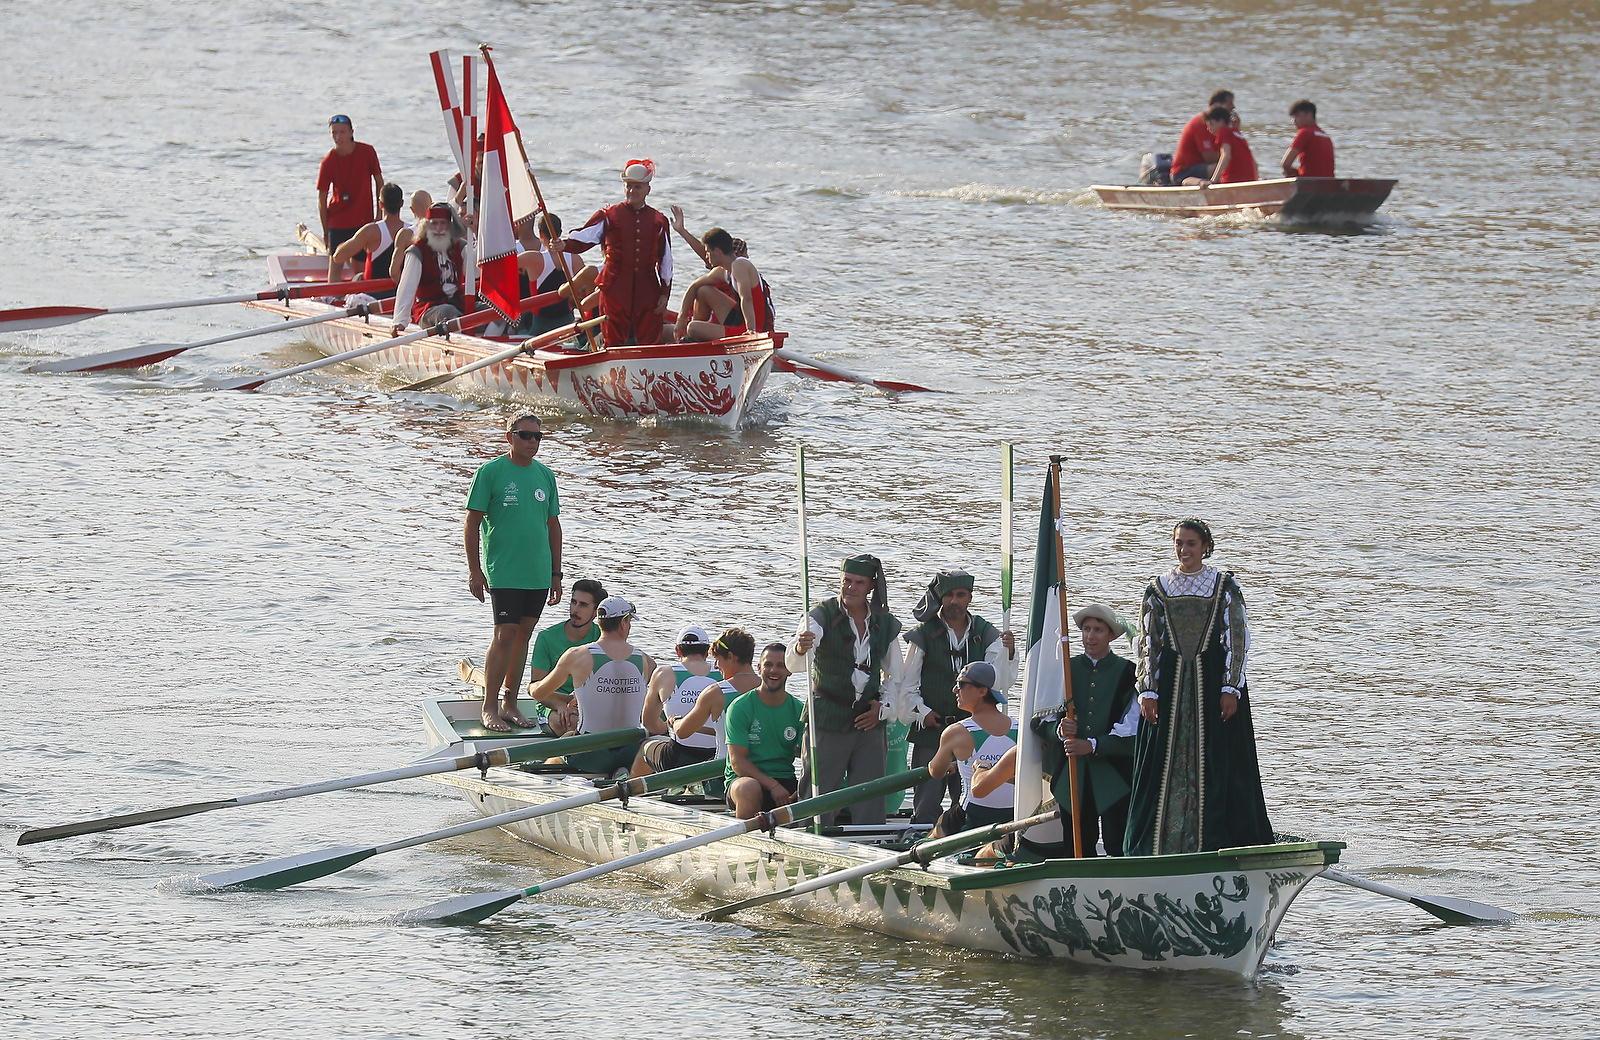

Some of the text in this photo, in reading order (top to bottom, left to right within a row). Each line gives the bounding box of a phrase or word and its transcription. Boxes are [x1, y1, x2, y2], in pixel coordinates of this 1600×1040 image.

[597, 676, 640, 685] CANOTTIERI
[596, 685, 640, 694] GIACOMELLI
[681, 689, 701, 697] CANO
